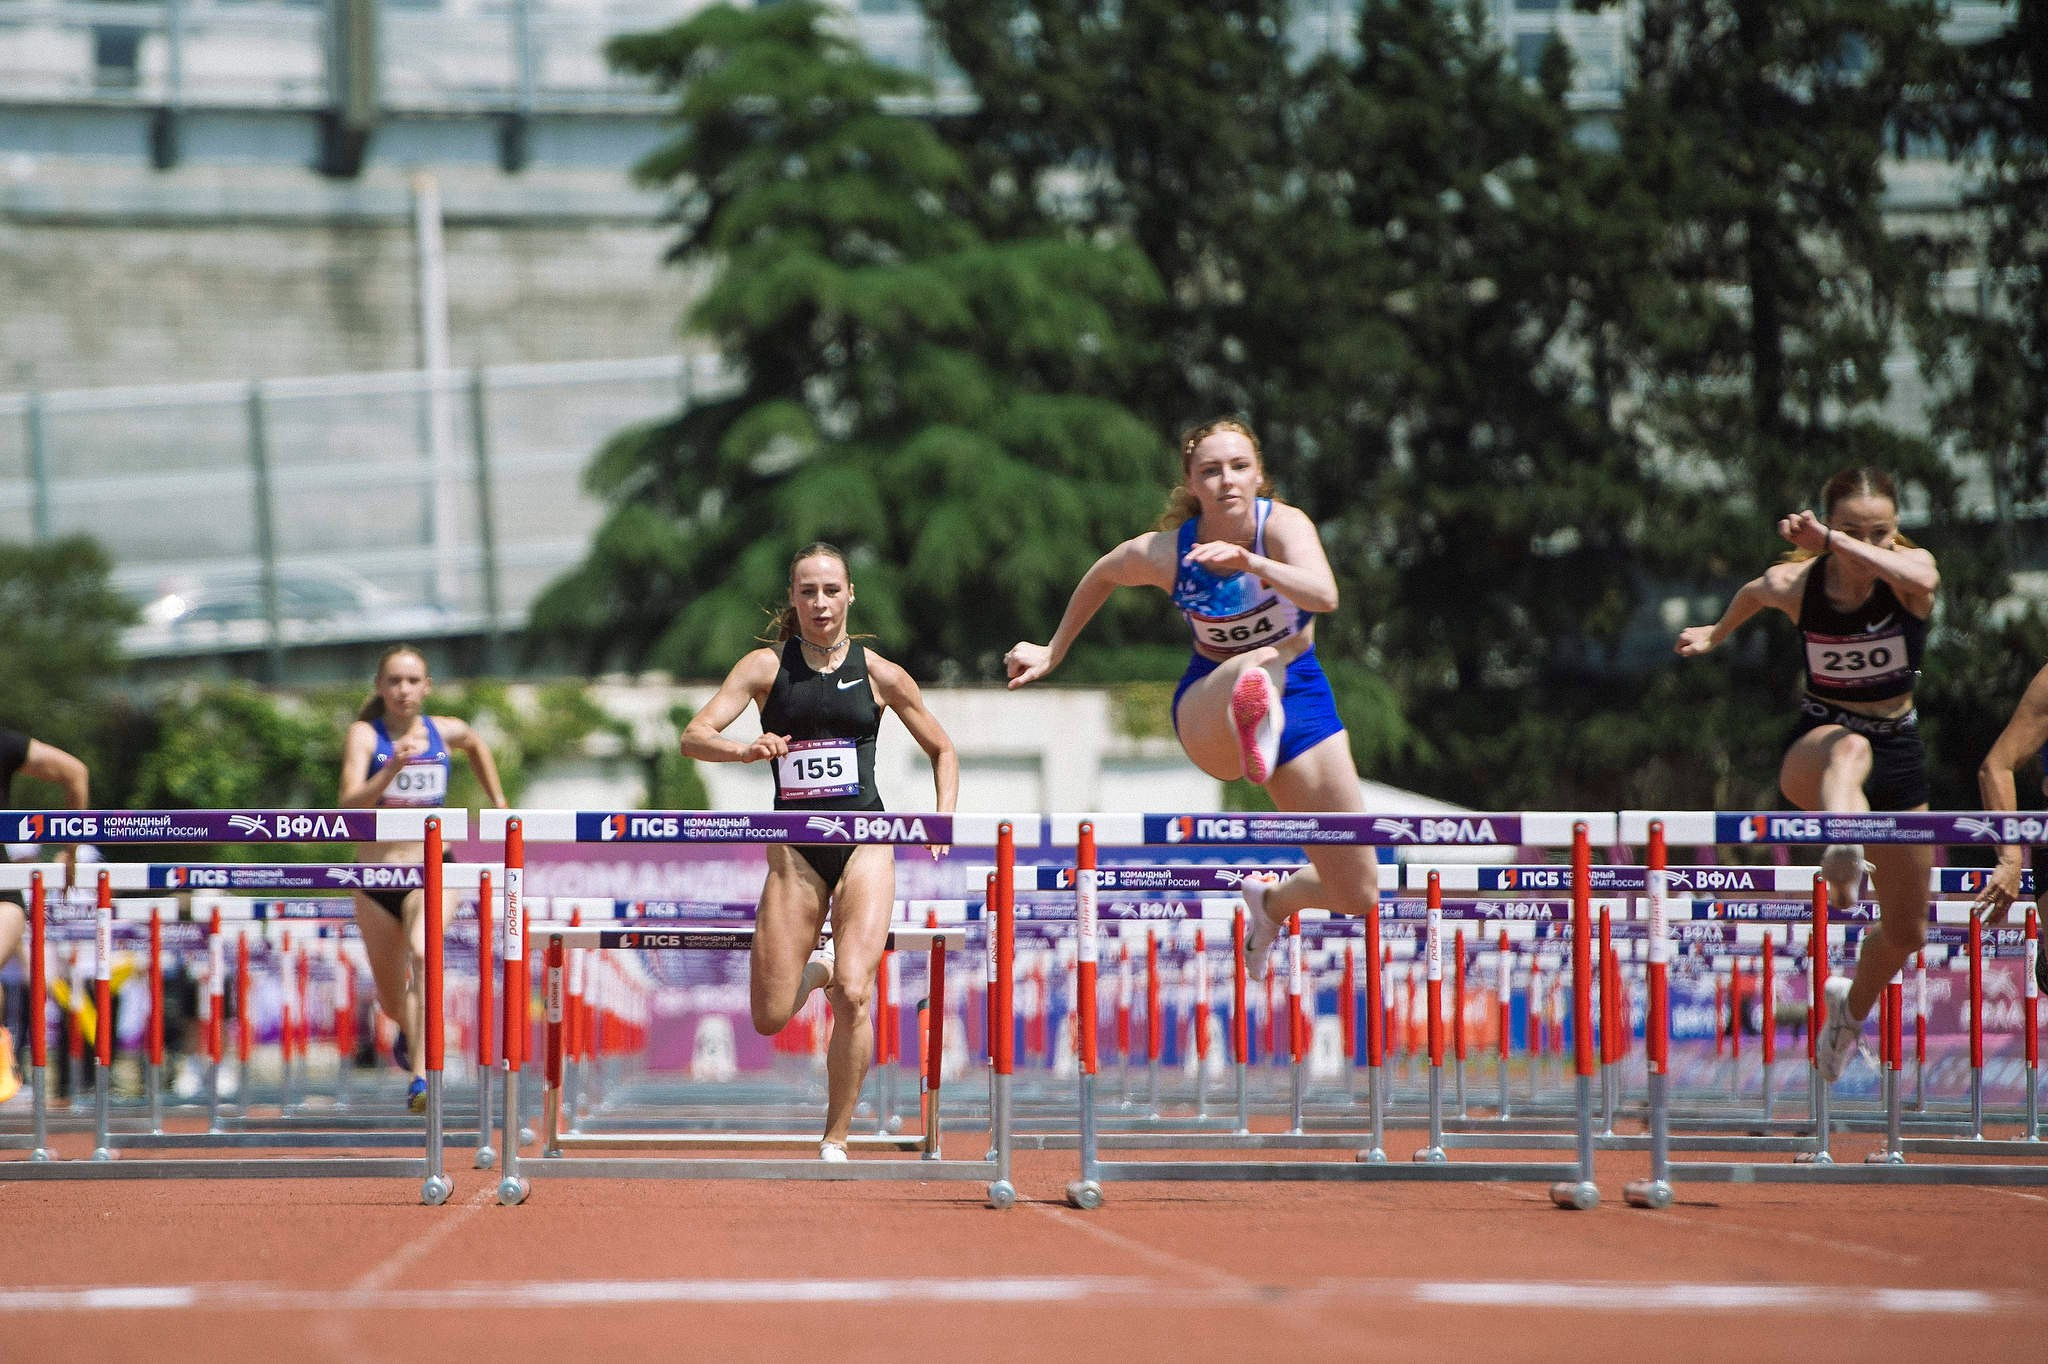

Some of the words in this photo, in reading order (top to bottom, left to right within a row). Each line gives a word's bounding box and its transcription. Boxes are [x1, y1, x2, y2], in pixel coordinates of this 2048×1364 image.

[1207, 616, 1274, 643] 364
[1822, 646, 1892, 671] 230
[792, 756, 843, 781] 155
[50, 817, 98, 837] ПСБ
[103, 814, 171, 827] КОМАНДНЫЙ
[276, 814, 350, 839] ВФЛА
[631, 817, 680, 838] ПСБ
[683, 815, 750, 828] КОМАНДНЫЙ
[854, 816, 928, 841] ВФЛА
[1197, 819, 1247, 839] ПСБ
[1771, 818, 1822, 838] ПСБ
[103, 827, 164, 838] ЧЕМПИОНАТ
[166, 827, 209, 837] РОССИИ
[683, 828, 743, 838] ЧЕМПИОНАТ
[745, 828, 788, 838] РОССИИ
[1420, 818, 1498, 843] ВФЛА
[189, 869, 229, 887] ПСБ
[362, 867, 424, 887] ВФЛА
[1095, 871, 1117, 886] СБ
[1119, 869, 1172, 879] КОМАНДНЫЙ
[1119, 878, 1167, 888] ЧЕМПИОНАТ
[1168, 878, 1200, 887] РОССИИ
[1521, 871, 1560, 887] ПСБ
[1696, 870, 1755, 889] ВФЛА
[508, 890, 518, 936] polanik
[1139, 903, 1188, 919] ВФЛА
[1504, 902, 1553, 920] ВФЛА
[1727, 903, 1758, 918] ПСБ
[644, 935, 681, 946] ПСБ
[684, 934, 736, 942] КОМАНДНЫЙ
[1431, 926, 1439, 961] polanik
